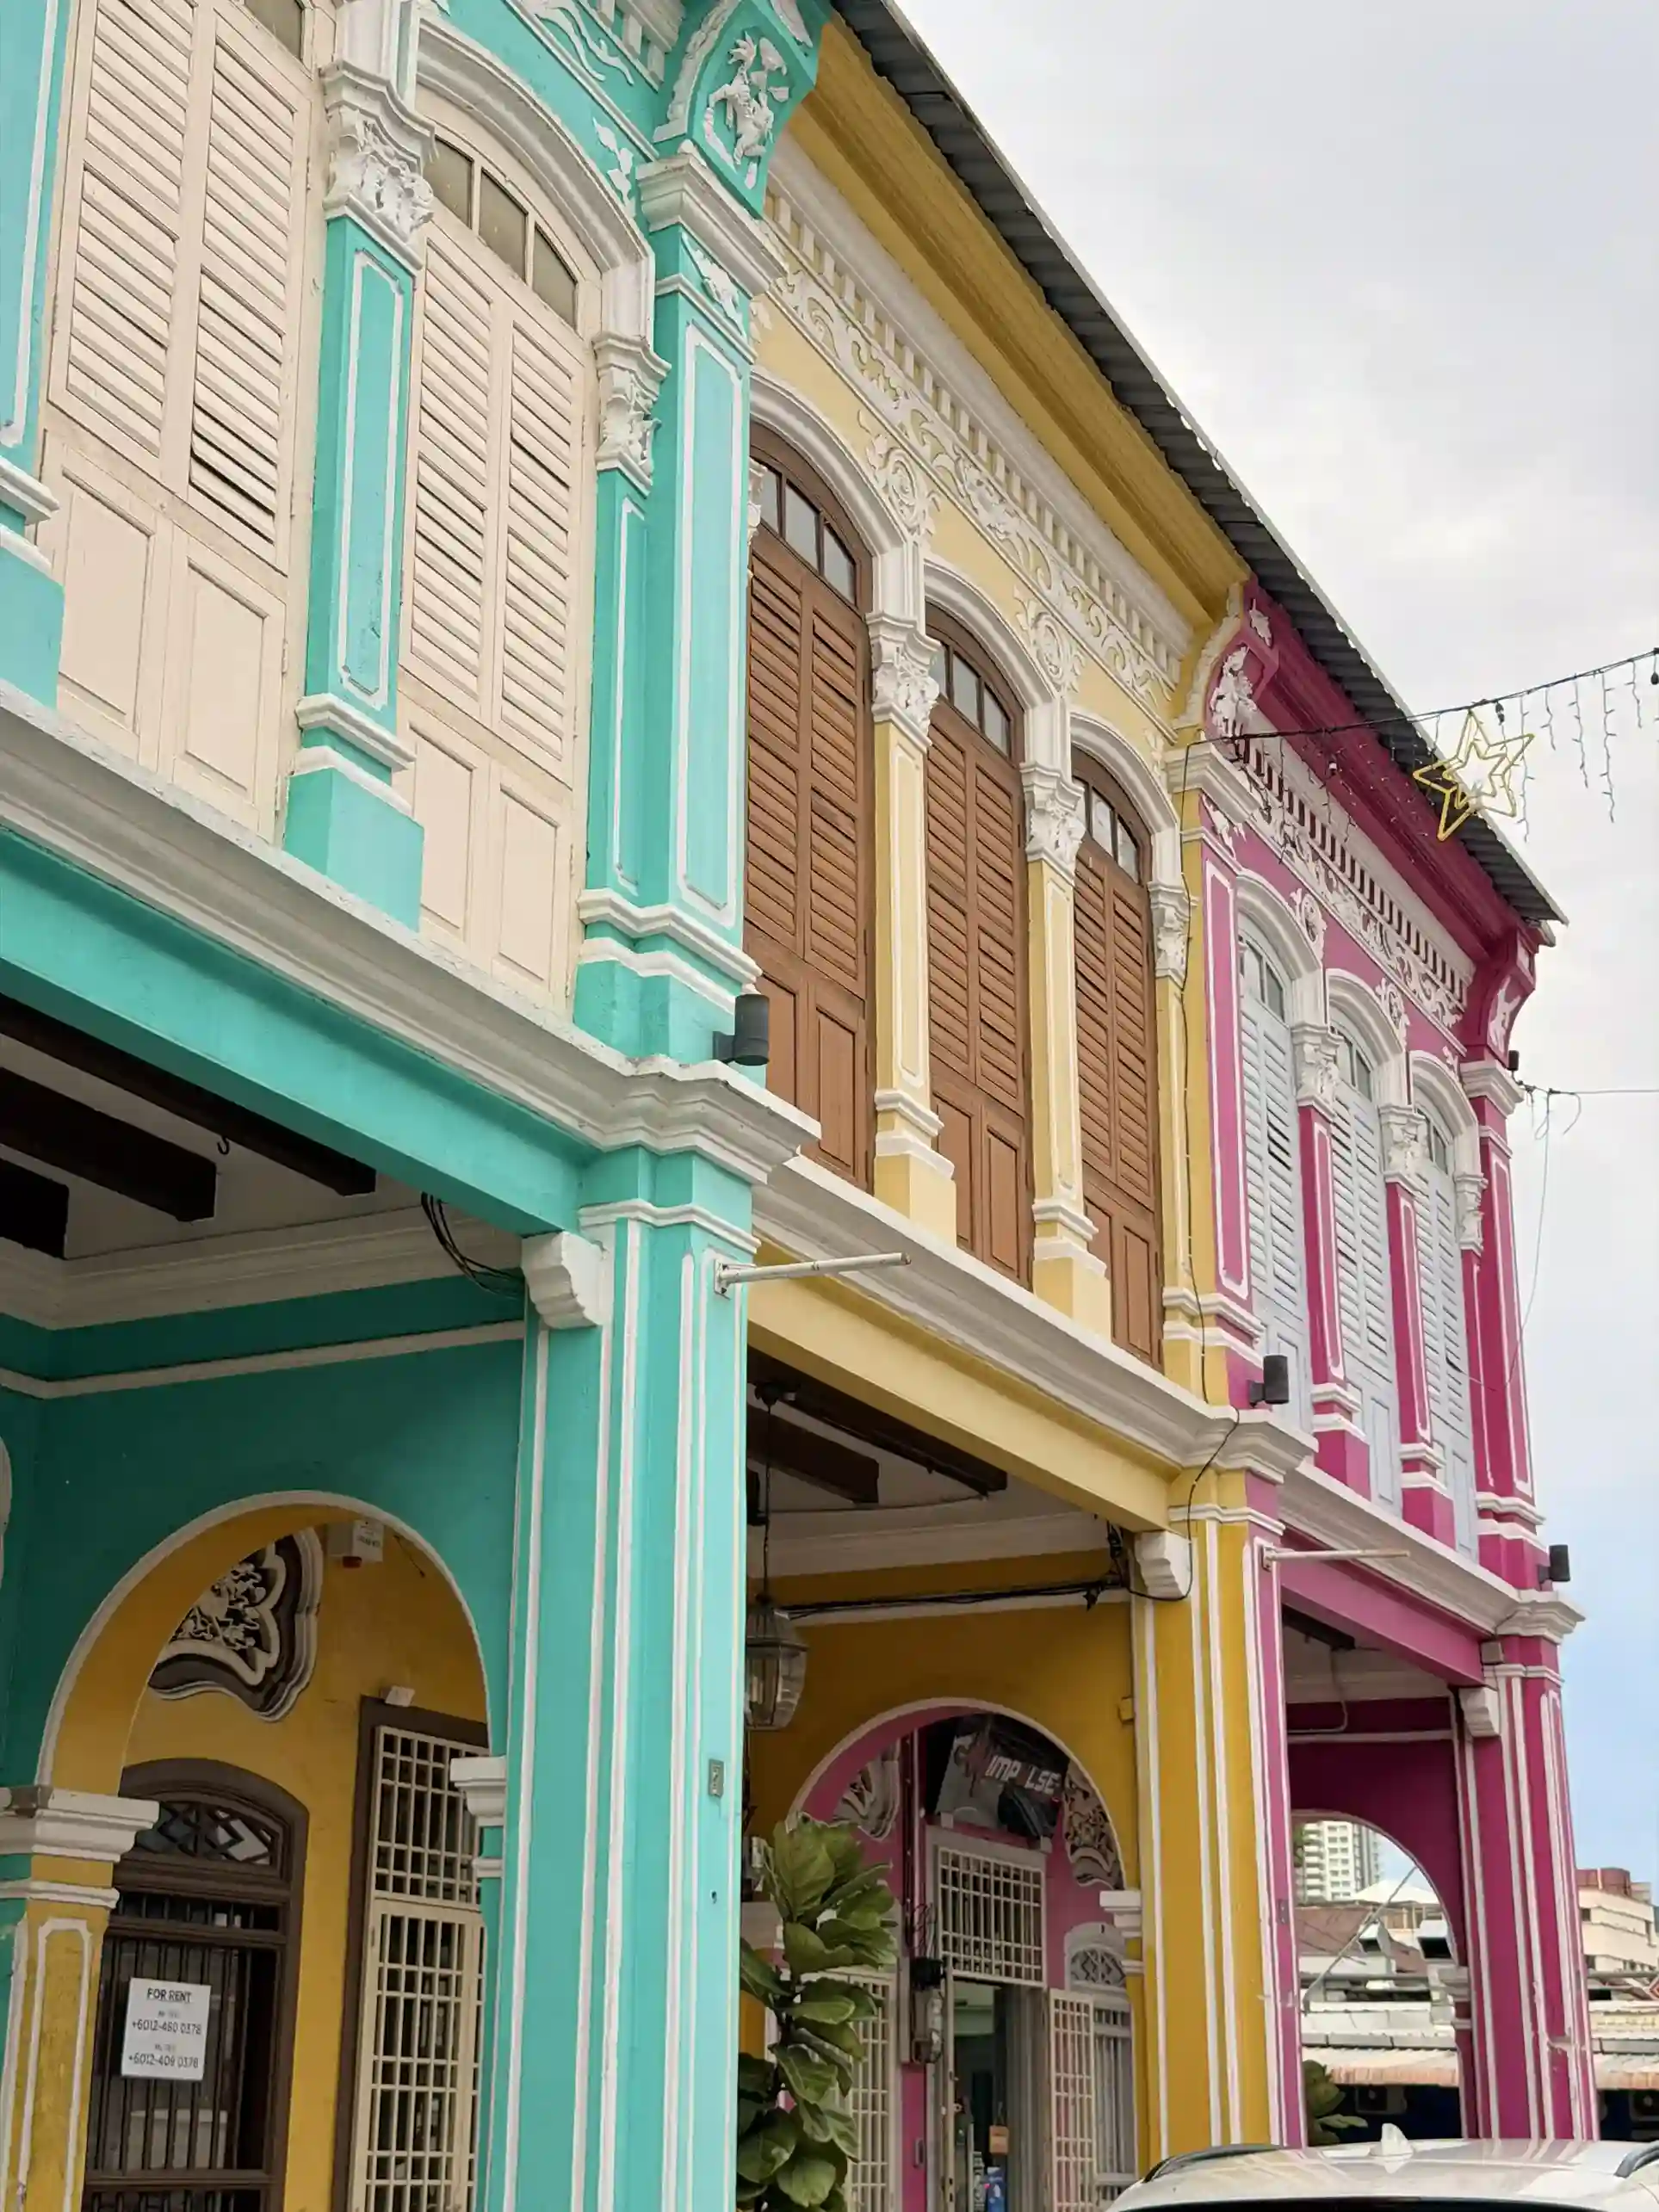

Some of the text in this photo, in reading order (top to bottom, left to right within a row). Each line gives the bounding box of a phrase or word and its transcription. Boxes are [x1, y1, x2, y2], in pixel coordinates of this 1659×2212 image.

[985, 1755, 1062, 1795] IMPLSE
[146, 1987, 192, 2004] FOR RENT
